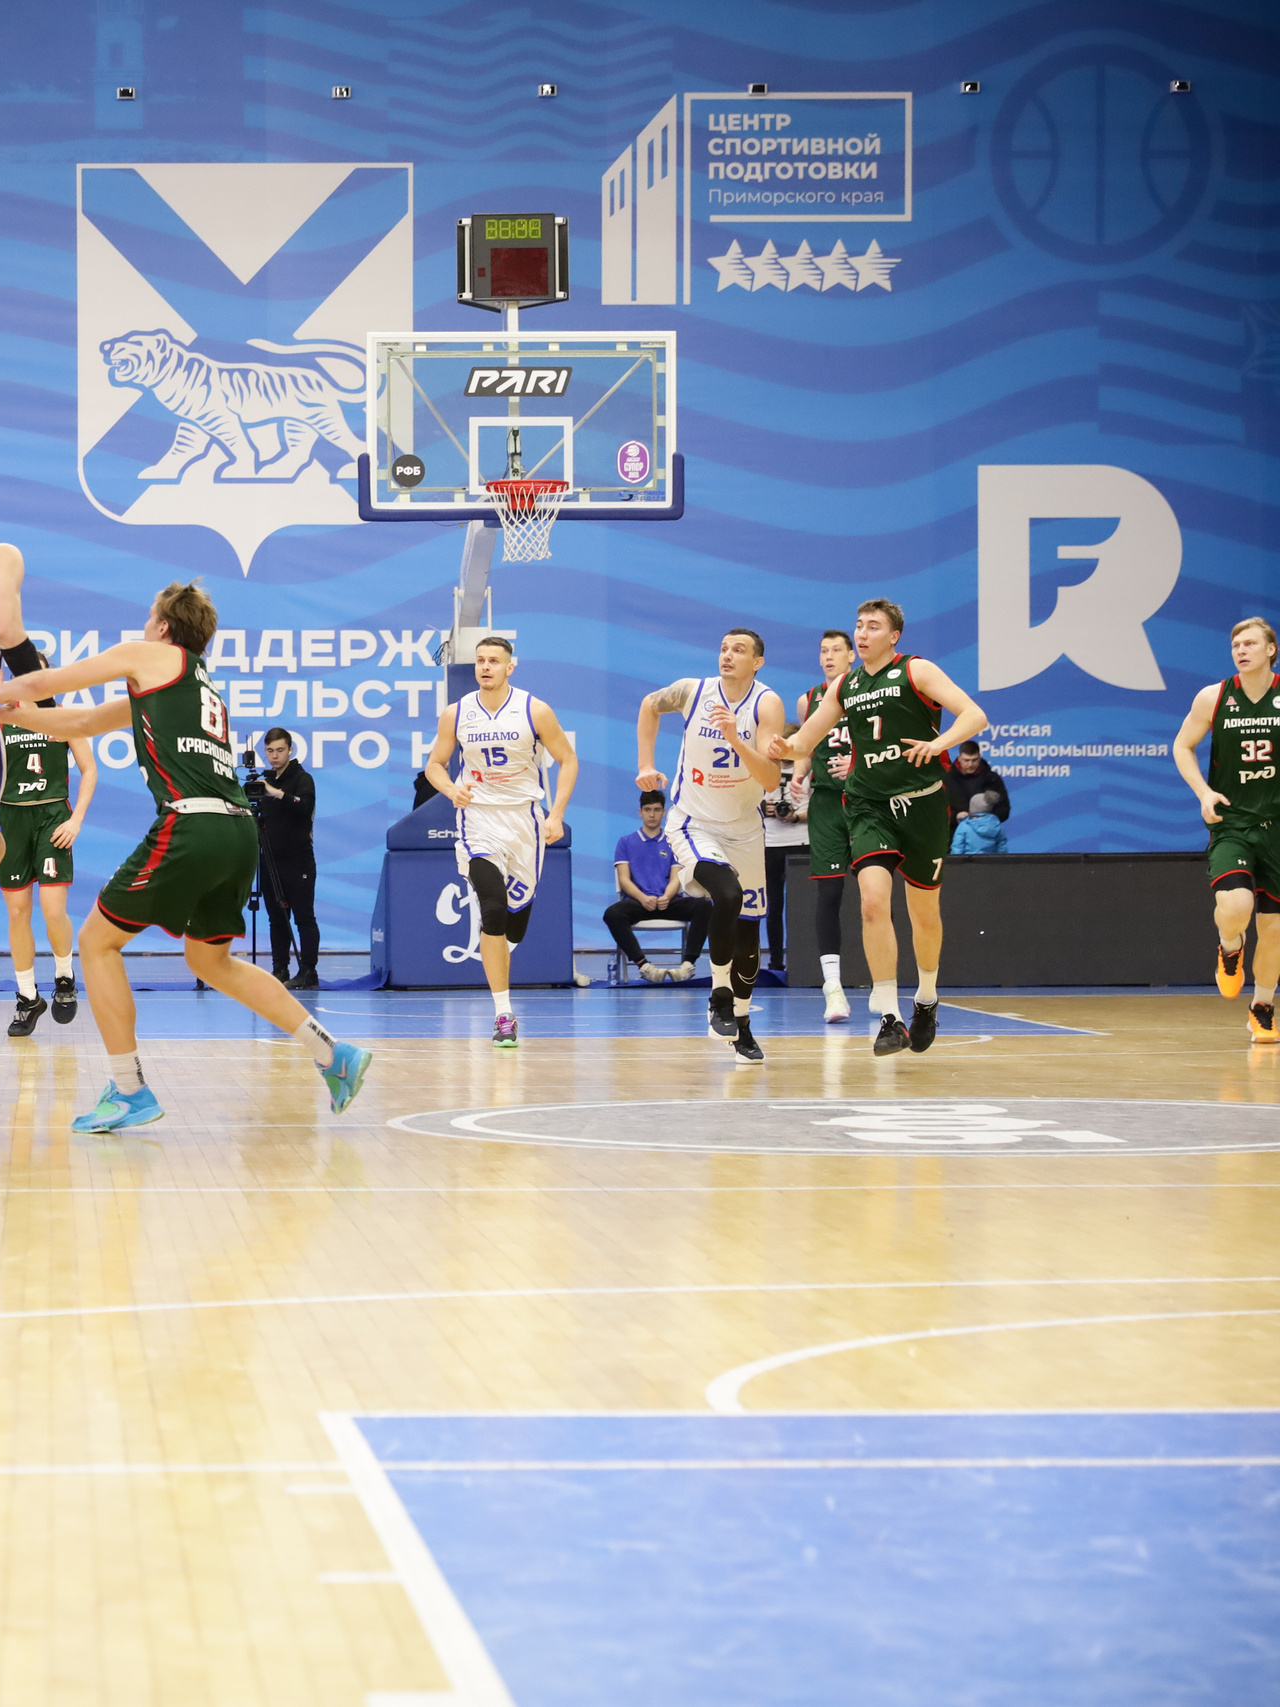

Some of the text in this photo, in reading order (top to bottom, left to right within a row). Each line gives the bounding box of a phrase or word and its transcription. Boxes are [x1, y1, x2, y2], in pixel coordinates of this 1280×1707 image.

[708, 113, 792, 134] ЦЕНТР
[707, 133, 882, 156] СПОРТИВНОЙ
[708, 162, 878, 182] ПОДГОТОВКИ
[708, 189, 885, 206] Приморского края
[467, 369, 569, 394] PARI
[396, 465, 421, 476] РФБ
[844, 686, 901, 710] ЛОКОМОТИВ
[866, 715, 882, 740] 7
[1223, 716, 1280, 729] ЛОКОМОТИ
[467, 732, 520, 743] ДИНАМО
[827, 726, 853, 748] 24
[481, 747, 508, 767] 15
[712, 747, 740, 768] 21
[978, 741, 1168, 761] Рыбопромышленная
[1240, 739, 1273, 762] 32
[26, 753, 43, 774] 4
[987, 762, 1070, 777] омпания
[43, 857, 58, 879] 4
[932, 857, 943, 881] 7
[742, 887, 766, 909] 21
